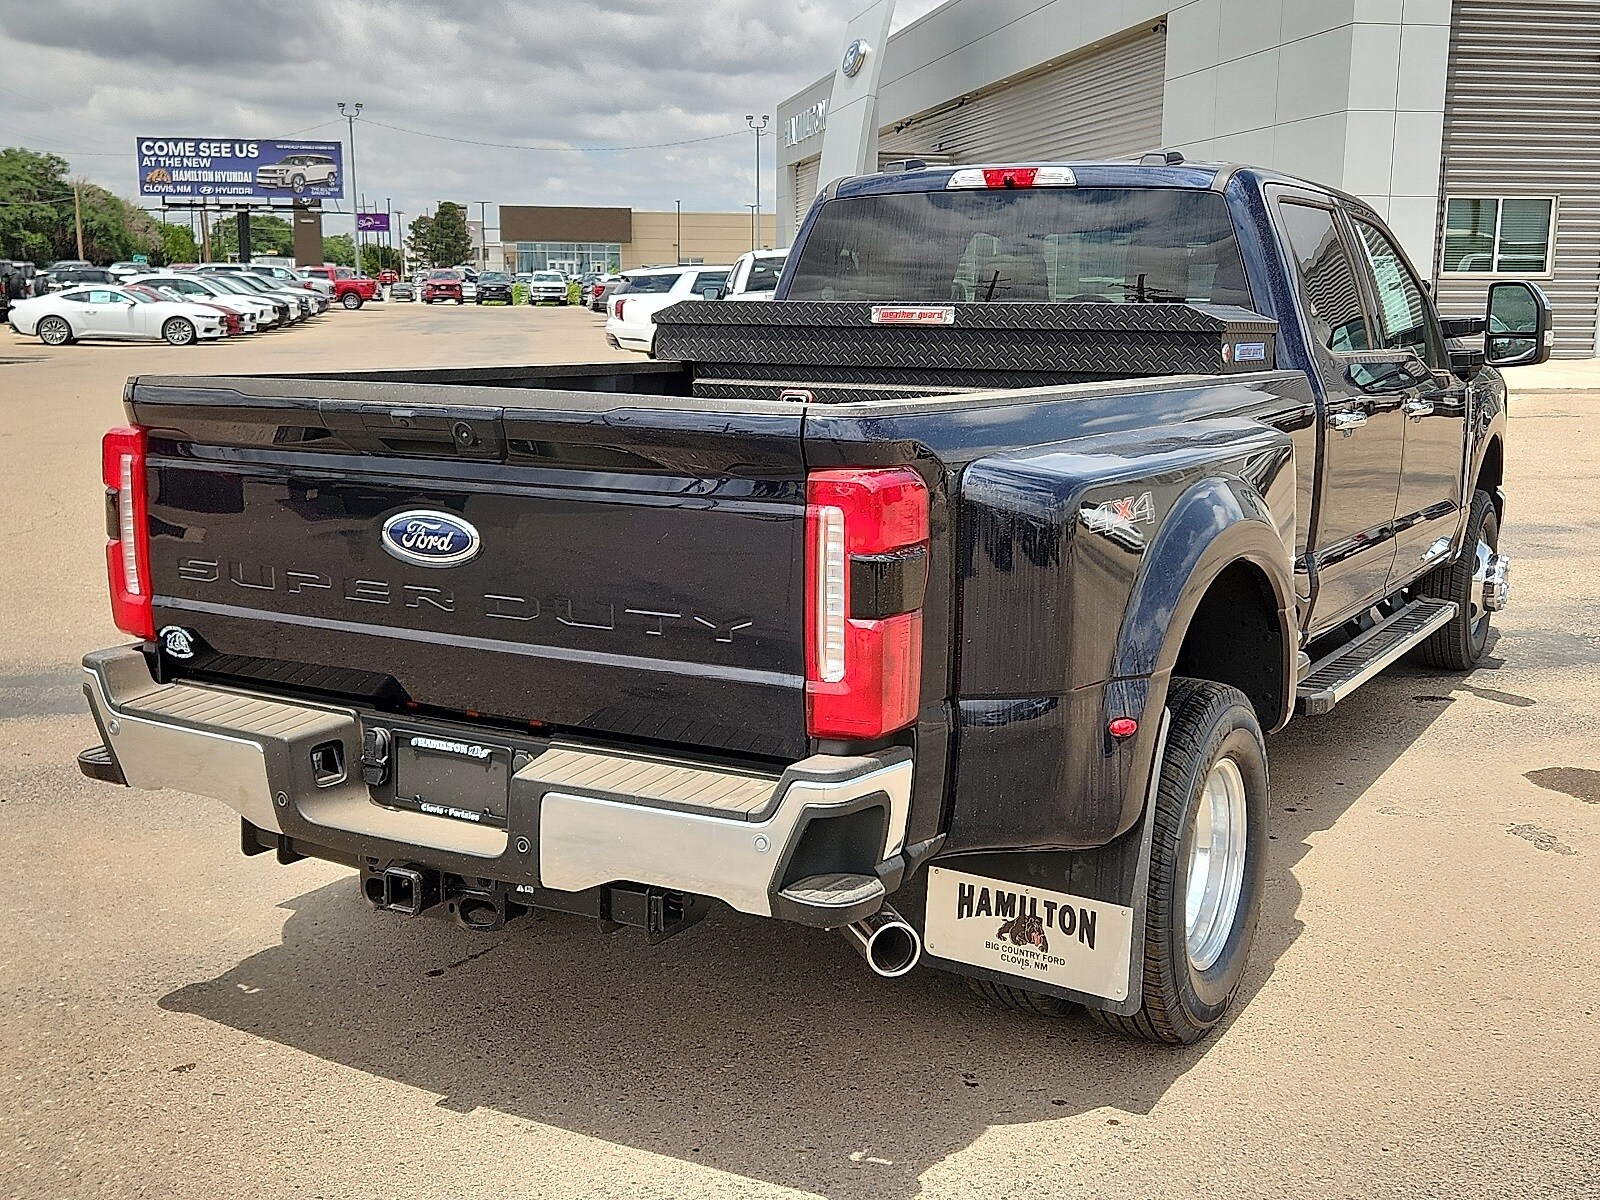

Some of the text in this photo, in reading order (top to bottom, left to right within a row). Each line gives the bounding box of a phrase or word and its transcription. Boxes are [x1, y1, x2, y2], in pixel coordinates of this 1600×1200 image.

[141, 141, 259, 158] COME SEE US
[142, 157, 211, 168] AT THE NEW
[172, 170, 252, 183] HAMILTON HYUNDAI
[143, 184, 253, 195] CLOVIS, NM HYUNDAI
[881, 310, 944, 320] weather guard
[402, 520, 454, 551] Ford
[178, 556, 752, 643] SUPER DUTY
[957, 882, 1097, 950] HAMILTON
[985, 941, 1066, 966] BIG COUNTRY FORD
[1000, 954, 1049, 971] CLOVIS, NM
